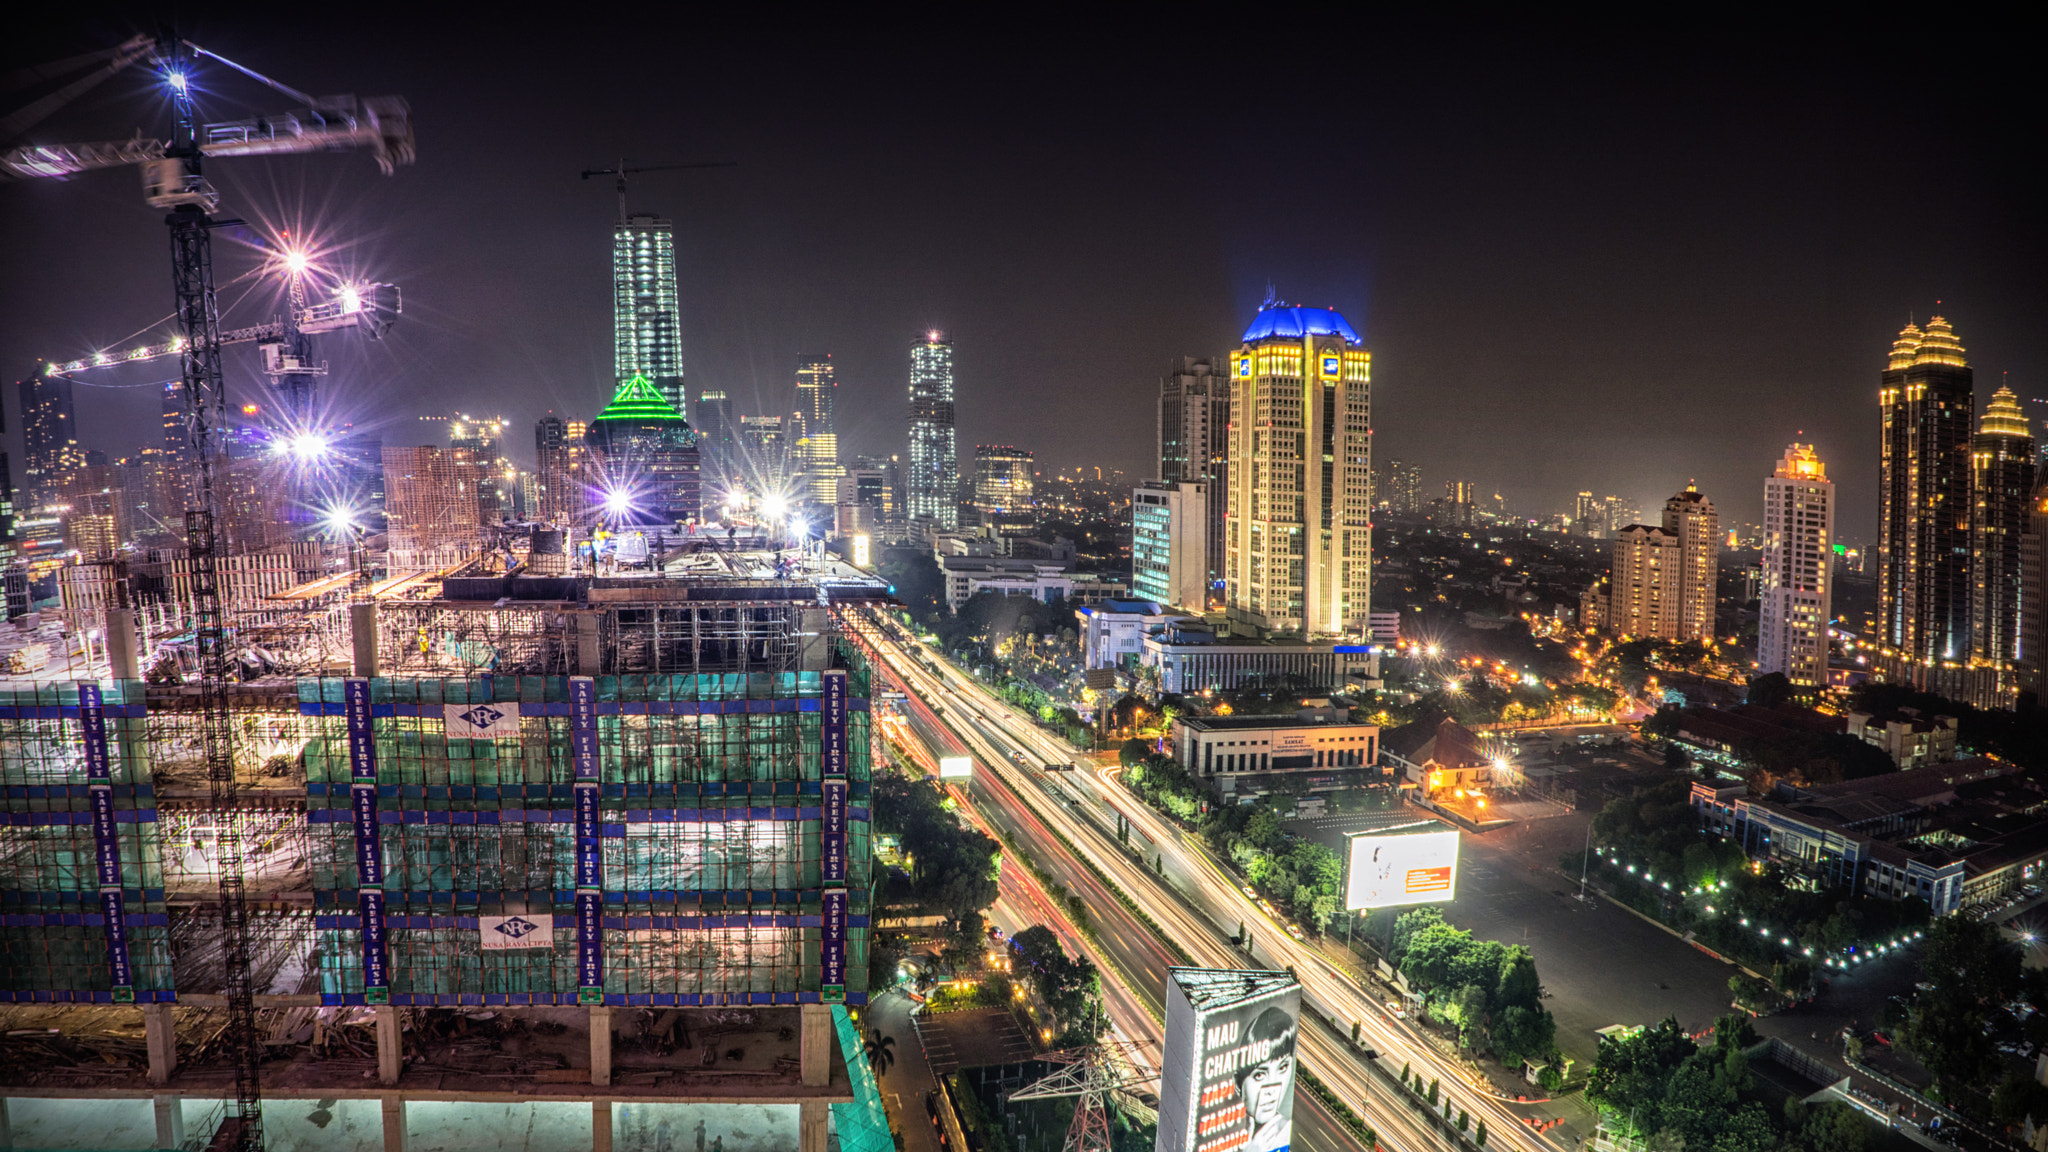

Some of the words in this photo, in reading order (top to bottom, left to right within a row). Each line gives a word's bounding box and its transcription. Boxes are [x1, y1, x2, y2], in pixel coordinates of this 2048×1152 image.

[354, 682, 364, 730] SAFETY
[470, 710, 499, 726] NRC
[578, 682, 589, 729] SAFETY
[831, 676, 839, 724] SAFETY
[86, 685, 98, 731] SAFETY
[92, 739, 102, 777] FIRST
[471, 731, 493, 739] RAYA
[495, 729, 519, 738] CIPTA
[357, 737, 368, 776] FIRST
[581, 737, 592, 776] FIRST
[831, 733, 840, 773] FIRST
[360, 789, 371, 836] SAFETY
[582, 789, 592, 836] SAFETY
[831, 785, 839, 832] SAFETY
[97, 791, 110, 836] SAFETY
[104, 844, 113, 883] FIRST
[365, 844, 374, 883] FIRST
[585, 845, 594, 884] FIRST
[830, 840, 839, 879] FIRST
[368, 894, 379, 940] SAFETY
[503, 921, 534, 936] NRC
[585, 895, 594, 940] SAFETY
[108, 894, 120, 939] SAFETY
[115, 947, 124, 985] FIRST
[505, 941, 527, 949] RAYA
[528, 940, 553, 948] CIPTA
[371, 948, 381, 986] FIRST
[586, 948, 595, 985] FIRST
[830, 946, 838, 984] FIRST
[1206, 1020, 1240, 1051] MAU
[1204, 1038, 1271, 1080] CHATTING
[1203, 1078, 1234, 1109] TAPI
[1200, 1101, 1245, 1138] TAKUT
